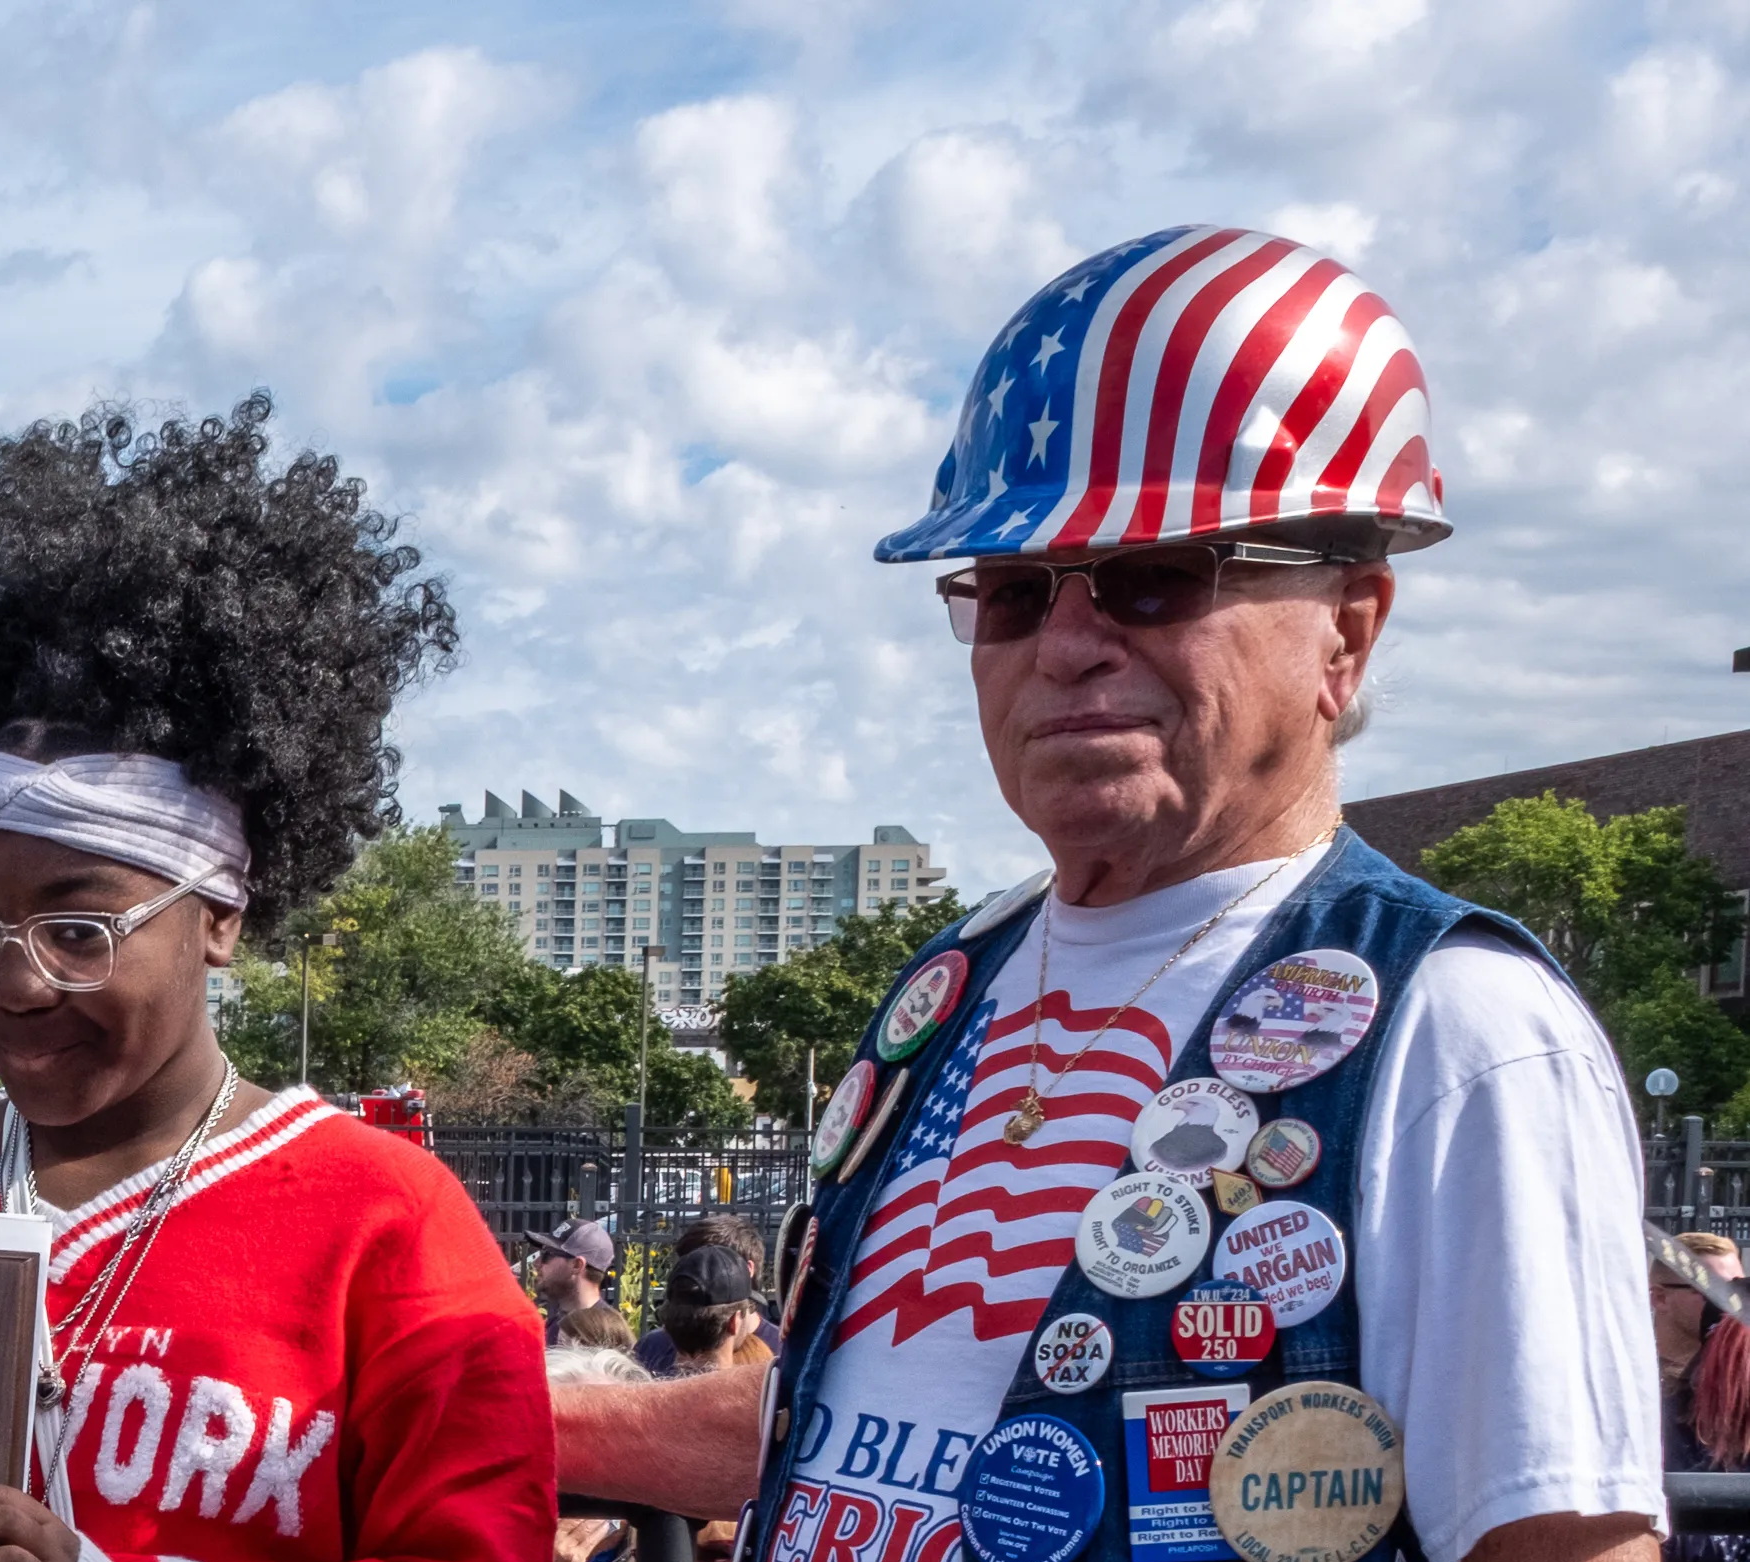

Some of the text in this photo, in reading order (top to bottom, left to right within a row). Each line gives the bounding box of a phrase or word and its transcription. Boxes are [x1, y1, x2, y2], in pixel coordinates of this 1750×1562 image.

[1274, 981, 1340, 1001] BY BIRTH
[1223, 1031, 1319, 1066] UNION
[1222, 1054, 1298, 1077] BY CHOICE
[1157, 1082, 1250, 1119] GOD BLESS
[1110, 1182, 1199, 1235] RIGHT TO STRIKE
[1226, 1211, 1309, 1255] UNITED
[1092, 1221, 1181, 1275] RIGHT TO ORGANIZE
[1260, 1242, 1282, 1257] WE
[1288, 1271, 1332, 1298] we beg!
[1058, 1322, 1089, 1338] NO
[1178, 1305, 1263, 1338] SOLID
[1038, 1344, 1103, 1360] SODA
[1202, 1340, 1237, 1359] 250
[1047, 1366, 1089, 1382] TAX
[1149, 1406, 1225, 1434] WORKERS
[1227, 1393, 1397, 1459] TRANSPORT WORKERS UNION
[982, 1421, 1090, 1478] UNION WOMEN
[1175, 1459, 1204, 1483] DAY
[1241, 1467, 1383, 1512] CAPTAIN
[1141, 1504, 1179, 1516] Right
[1184, 1505, 1197, 1513] to
[1152, 1517, 1189, 1528] Right
[1194, 1517, 1208, 1525] to
[961, 1504, 981, 1551] Coalition
[980, 1549, 990, 1560] of
[1138, 1530, 1175, 1542] Right
[1168, 1544, 1218, 1553] PHILAPOSH
[1234, 1530, 1272, 1562] LOCAL
